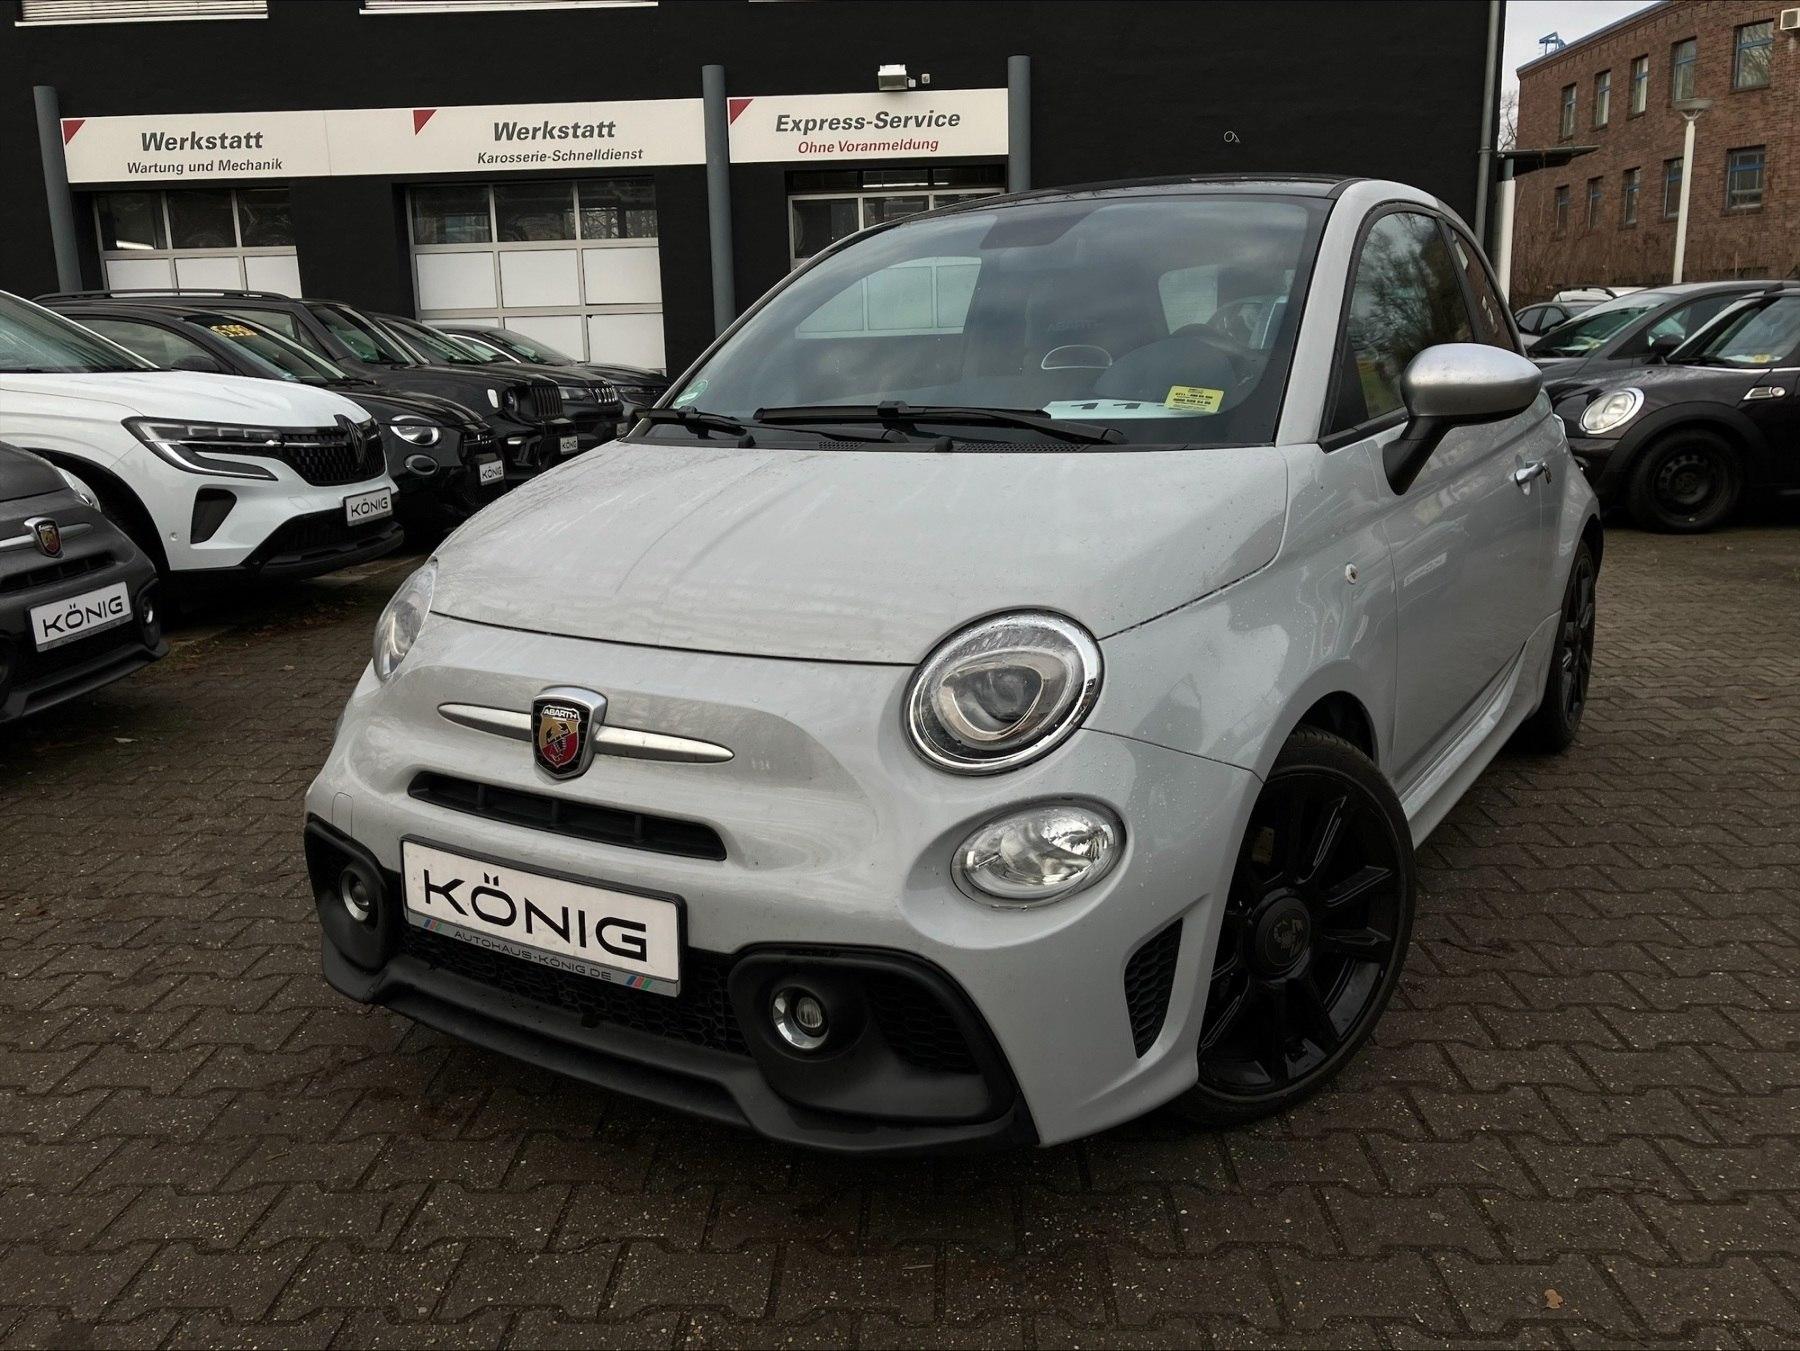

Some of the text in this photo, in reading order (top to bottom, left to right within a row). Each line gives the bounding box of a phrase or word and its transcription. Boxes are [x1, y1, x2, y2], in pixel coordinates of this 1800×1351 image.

[493, 120, 616, 141] Werkstatt
[775, 109, 961, 136] Express-Service
[141, 131, 263, 151] Werkstatt
[797, 138, 939, 154] Ohne Voranmeldung
[477, 148, 643, 164] Karosserie-Schnelldienst
[127, 158, 282, 175] Wartung und Mechanik
[351, 497, 388, 517] KÖNIG
[43, 595, 123, 637] KÖNIG
[543, 708, 577, 719] ABARTH
[423, 868, 648, 962] KÖNIG
